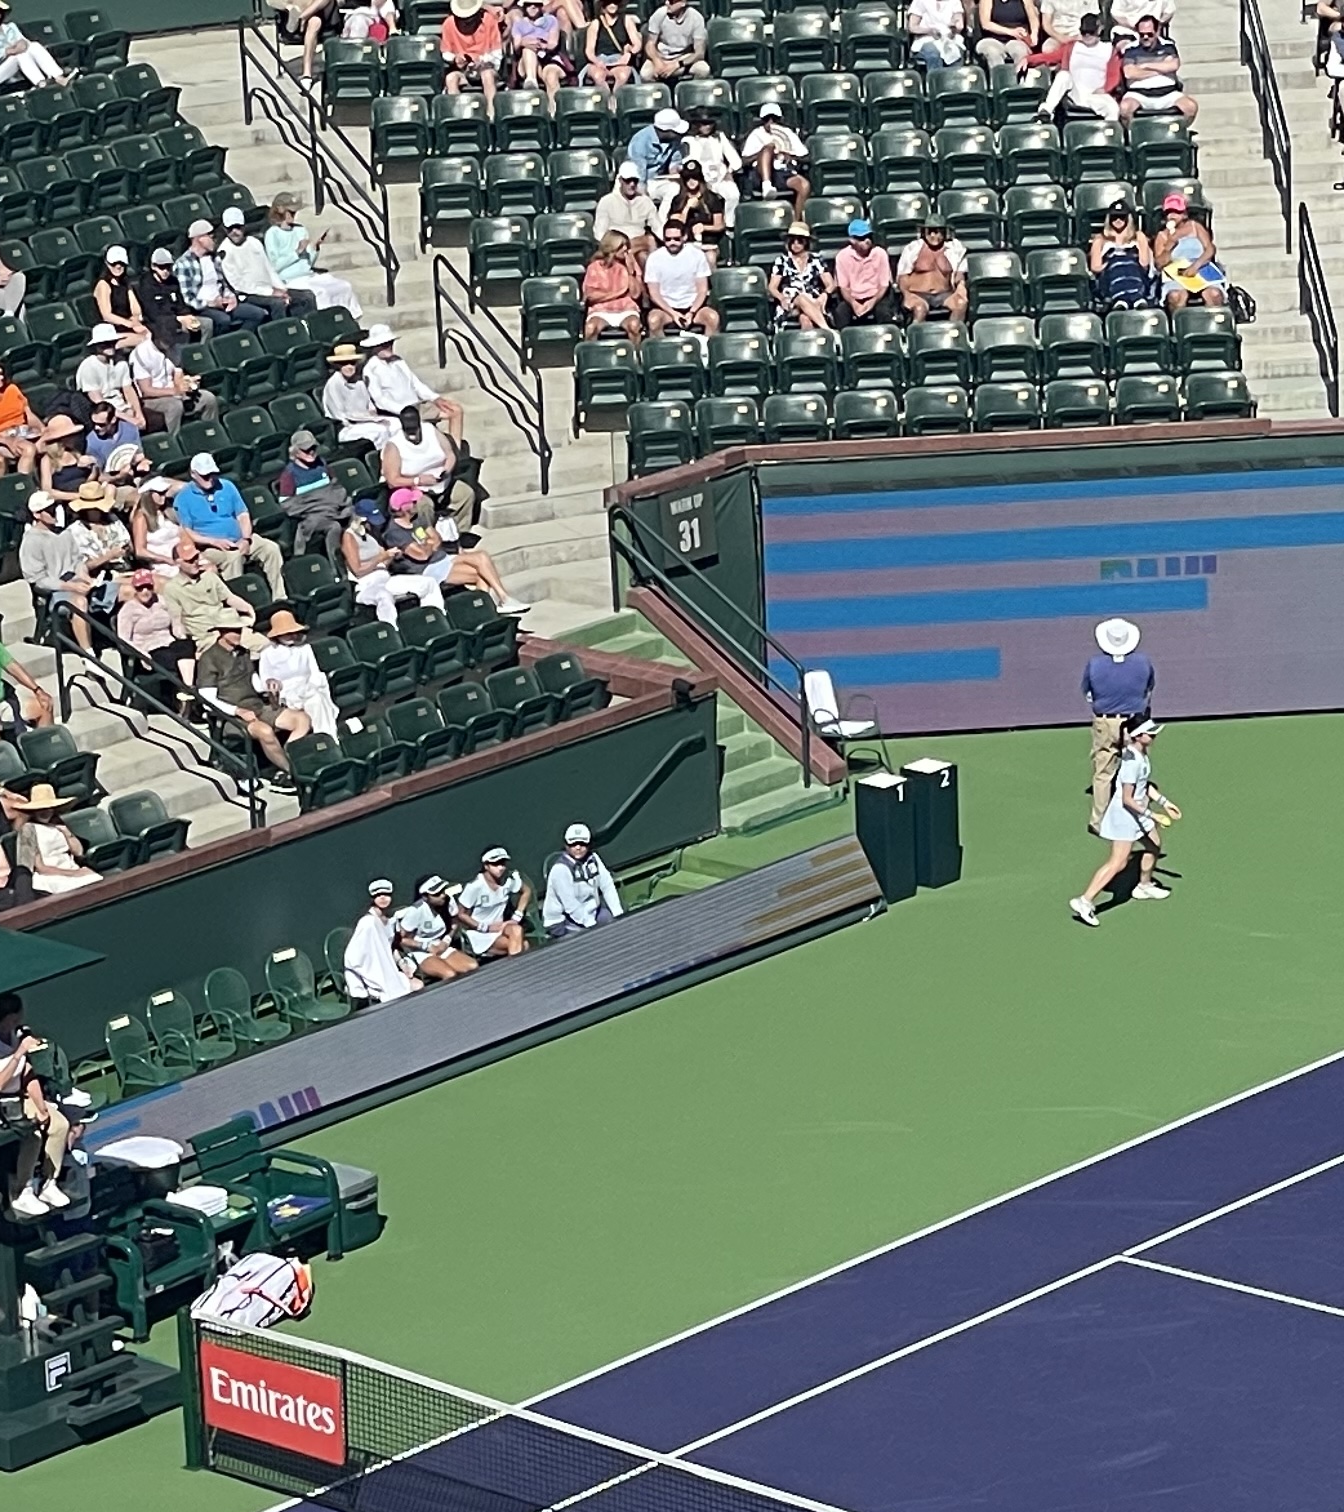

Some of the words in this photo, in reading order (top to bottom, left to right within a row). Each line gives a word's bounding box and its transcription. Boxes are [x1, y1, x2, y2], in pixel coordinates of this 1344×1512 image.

[678, 517, 701, 553] 31
[939, 769, 951, 788] 2
[896, 783, 905, 802] 1
[209, 1366, 336, 1435] Emirates
